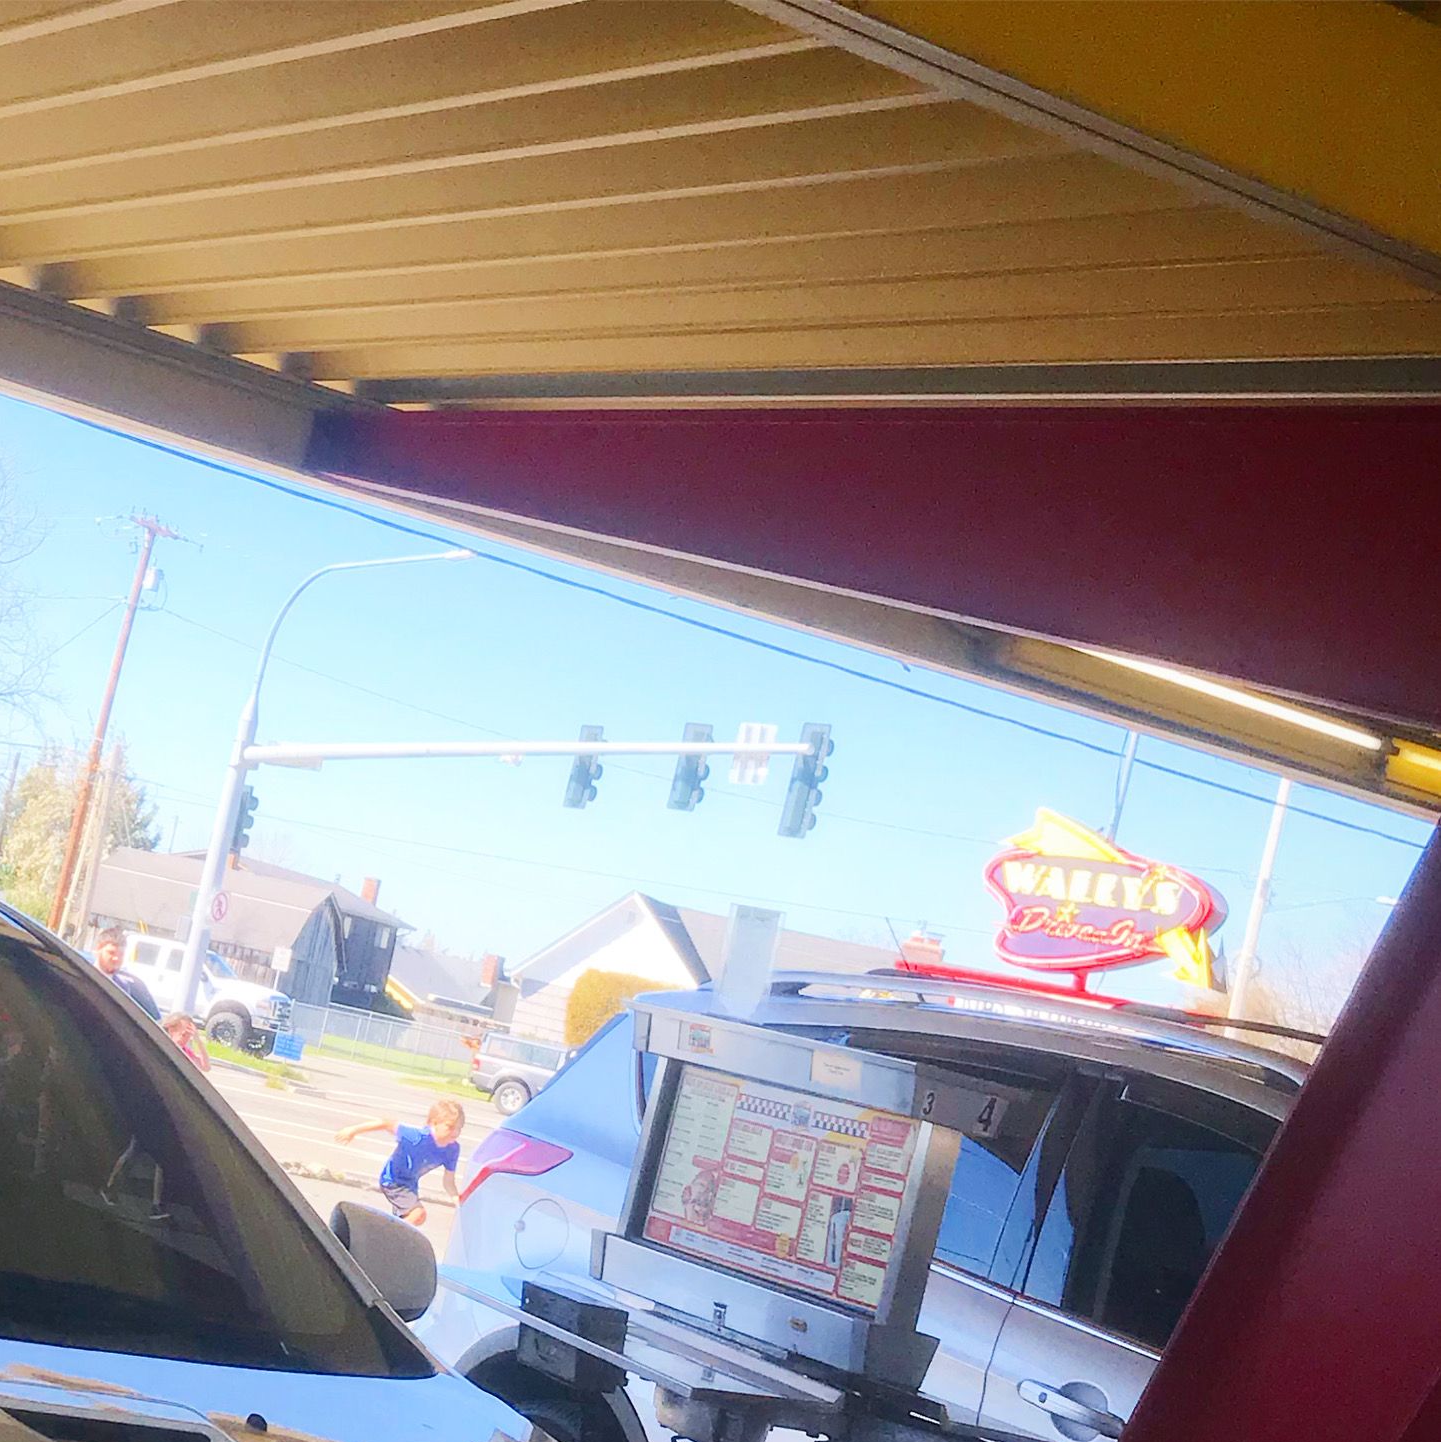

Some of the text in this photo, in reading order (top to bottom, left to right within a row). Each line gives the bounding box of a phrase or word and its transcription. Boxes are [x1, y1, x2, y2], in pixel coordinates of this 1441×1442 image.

[1002, 861, 1180, 916] WALLY'S
[922, 1091, 997, 1132] 3 4
